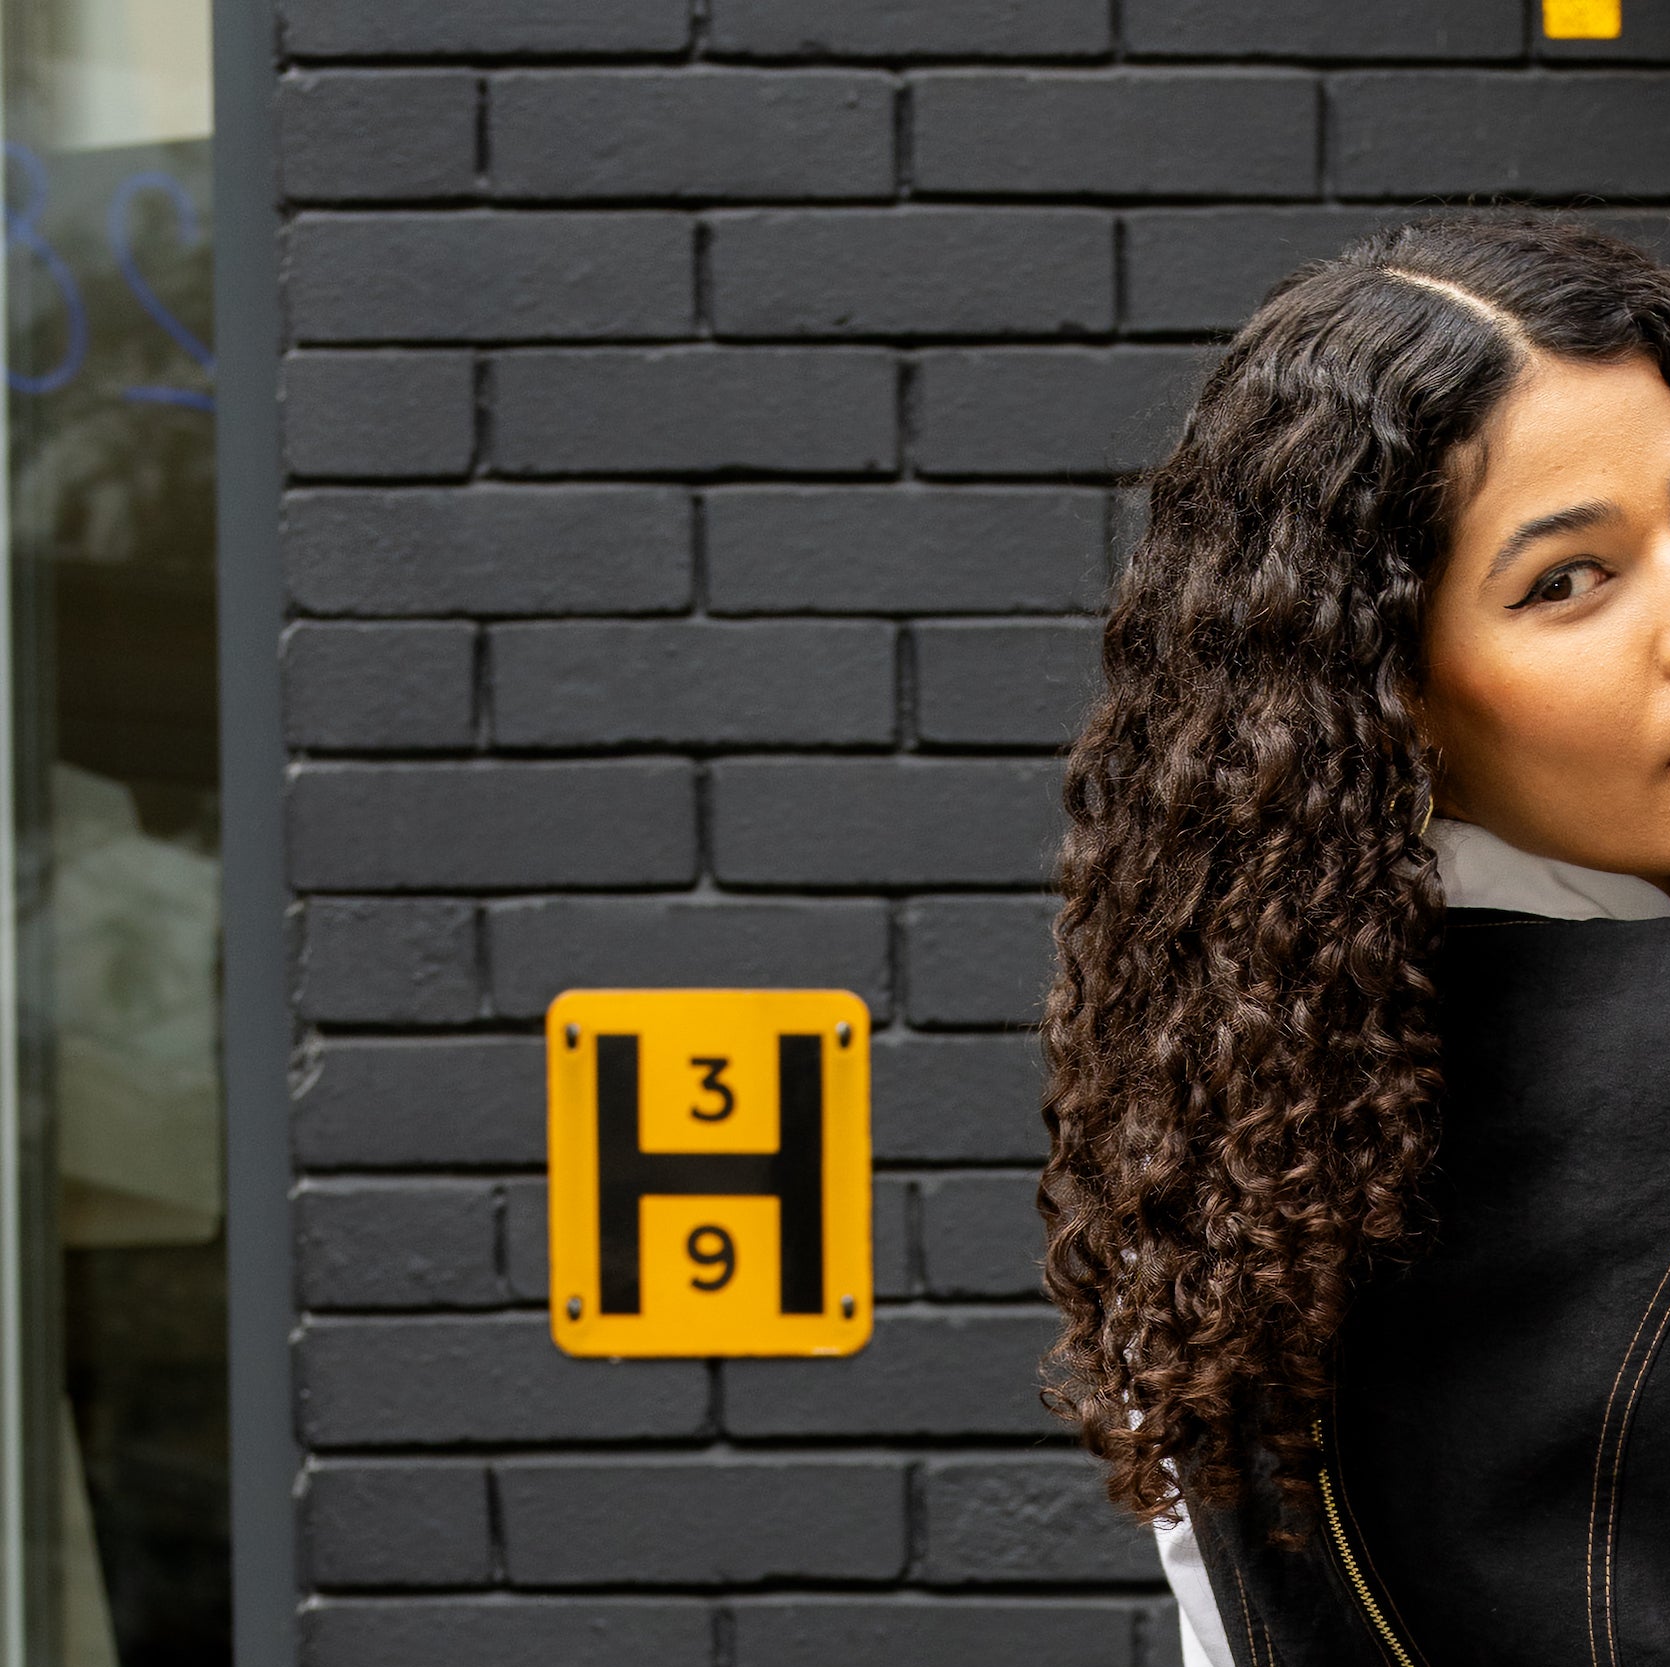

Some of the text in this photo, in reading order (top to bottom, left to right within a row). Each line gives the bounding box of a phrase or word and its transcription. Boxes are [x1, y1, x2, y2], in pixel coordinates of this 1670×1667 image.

[689, 1056, 736, 1123] 3
[596, 1034, 823, 1315] H
[686, 1223, 738, 1292] 9
